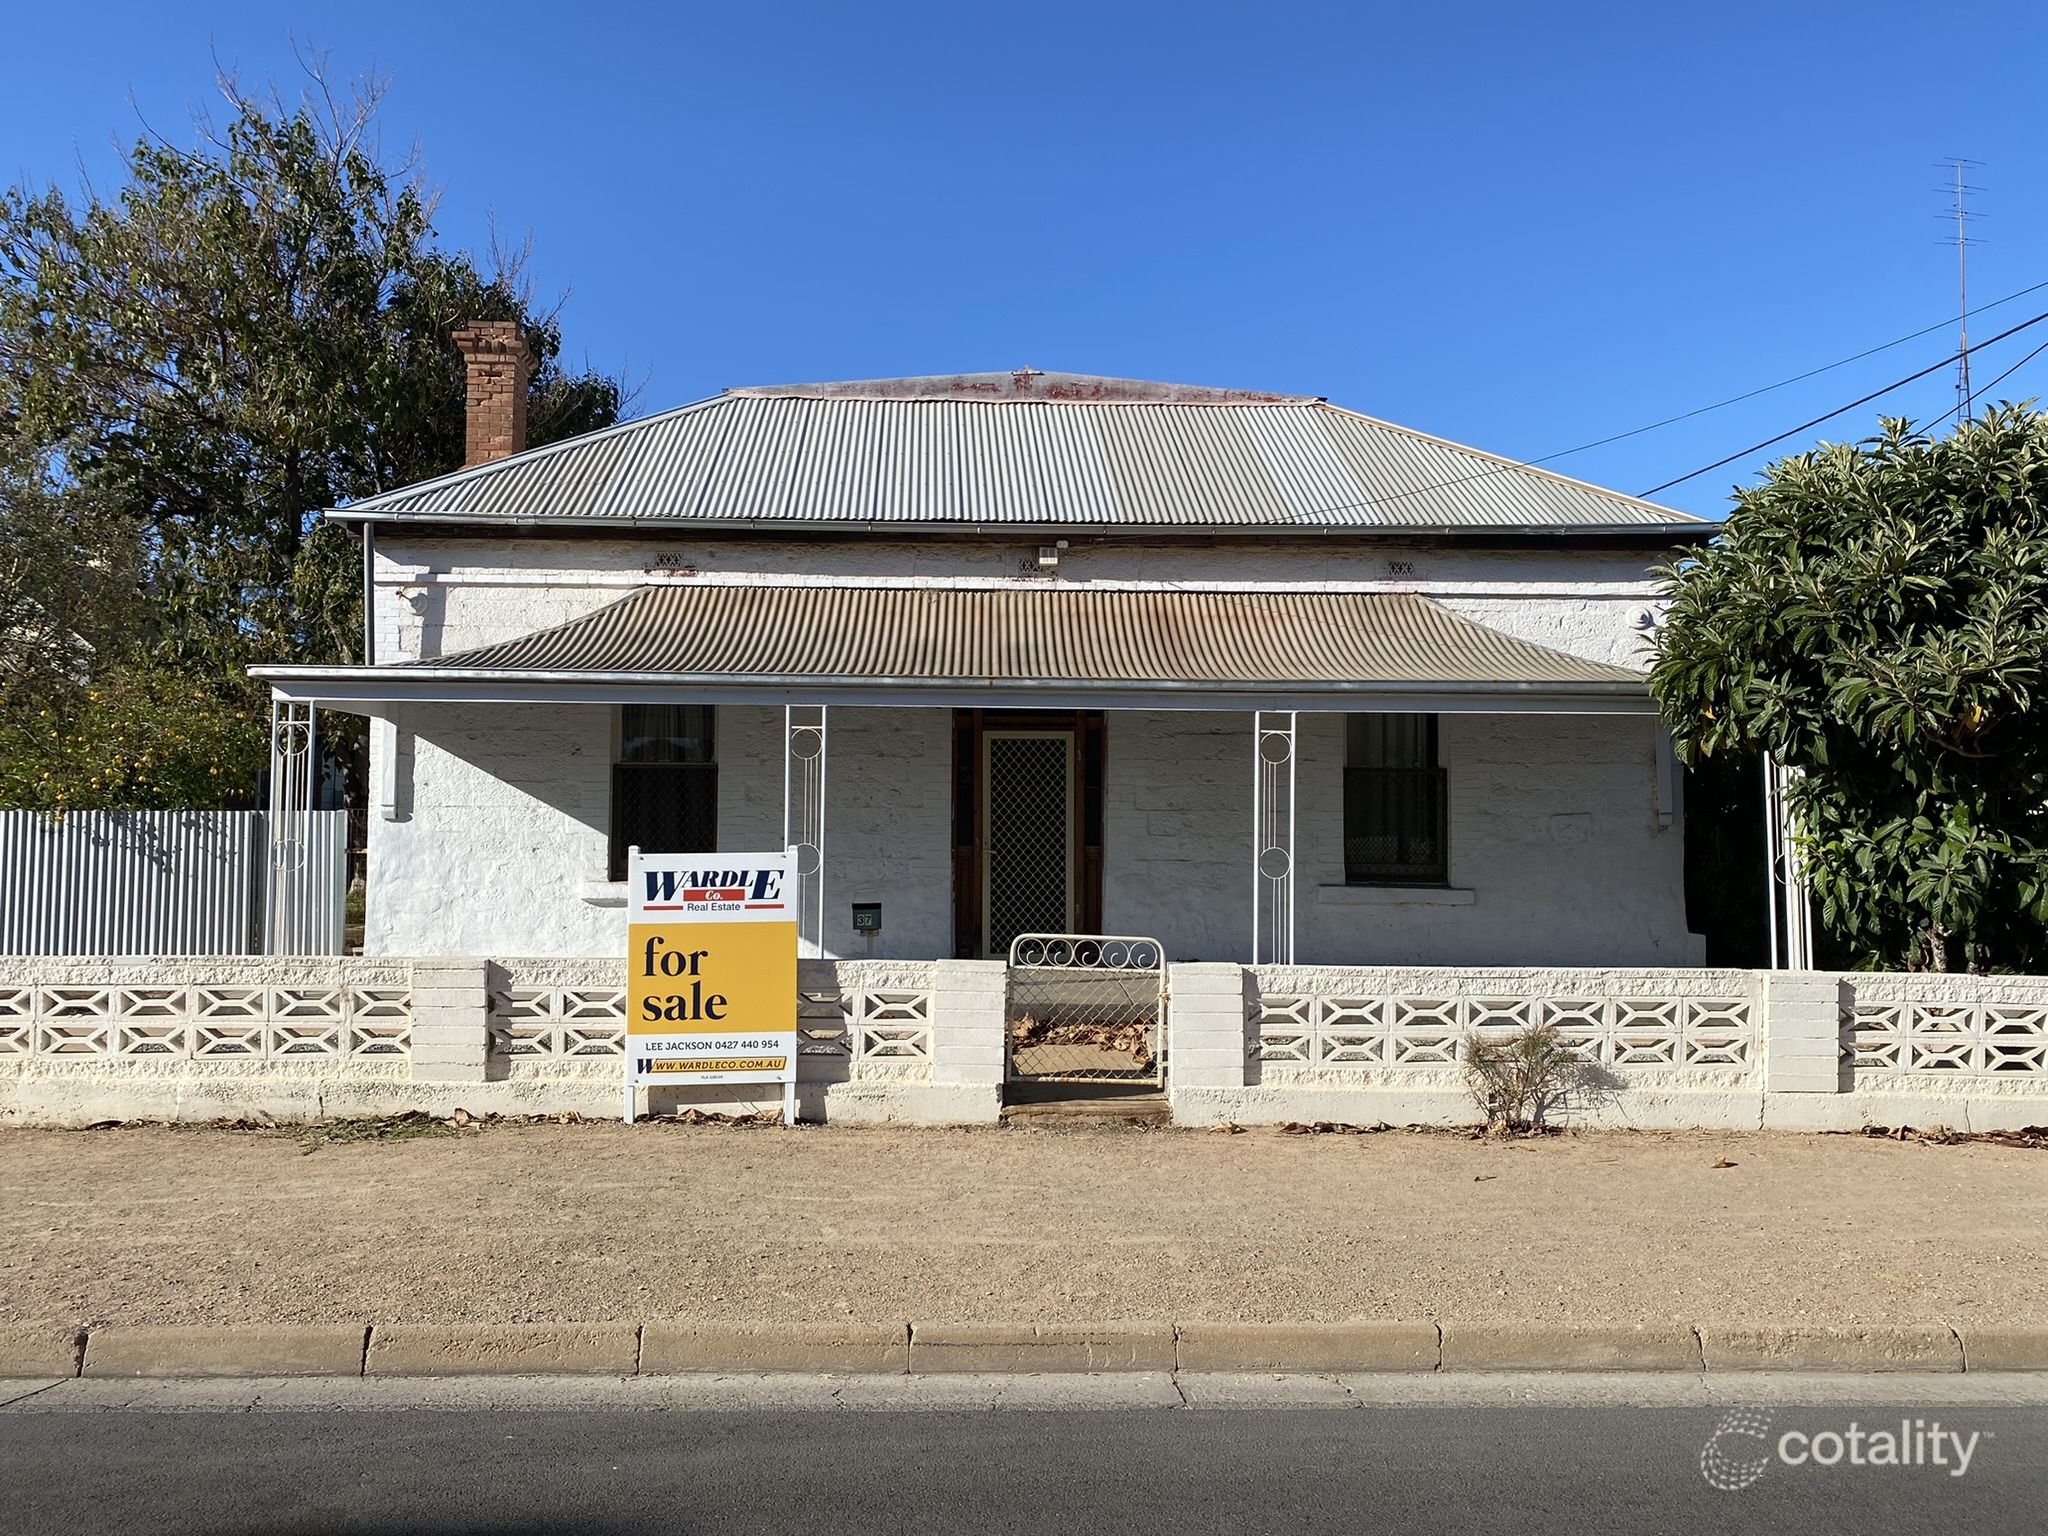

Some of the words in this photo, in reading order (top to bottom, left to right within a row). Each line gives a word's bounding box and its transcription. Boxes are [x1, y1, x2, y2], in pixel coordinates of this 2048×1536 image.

[644, 870, 784, 901] WARDLE
[705, 890, 723, 900] Co.
[687, 903, 708, 911] Real
[711, 902, 741, 911] Estate
[857, 915, 872, 925] 37
[642, 936, 709, 976] for
[642, 980, 728, 1021] sale
[645, 1042, 663, 1051] LEE
[665, 1041, 713, 1051] JACKSON
[715, 1041, 738, 1050] 0427
[740, 1040, 759, 1049] 440
[761, 1040, 779, 1049] 954
